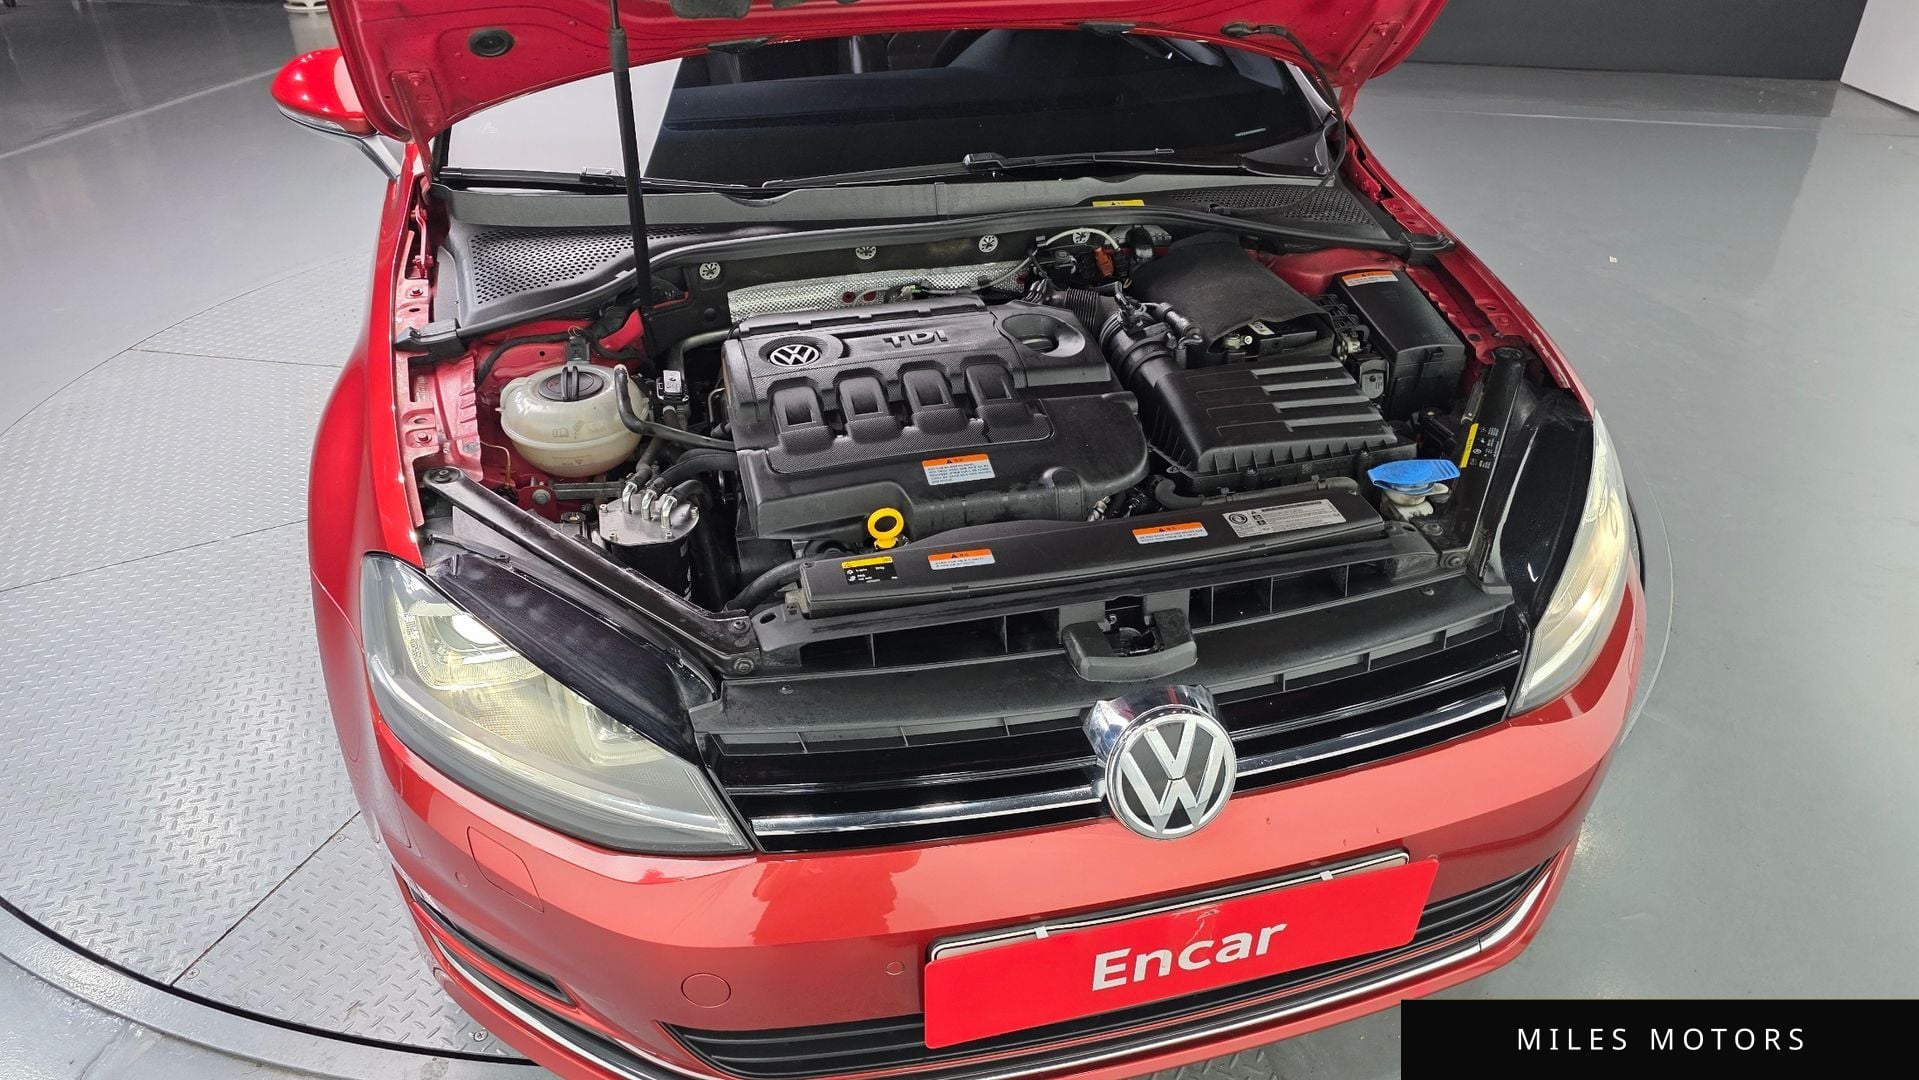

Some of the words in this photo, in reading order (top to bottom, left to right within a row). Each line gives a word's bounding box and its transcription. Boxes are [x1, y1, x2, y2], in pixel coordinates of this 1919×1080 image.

[770, 344, 820, 366] VW
[883, 329, 948, 348] TDI
[1112, 711, 1231, 835] VW
[1091, 922, 1288, 992] Encar
